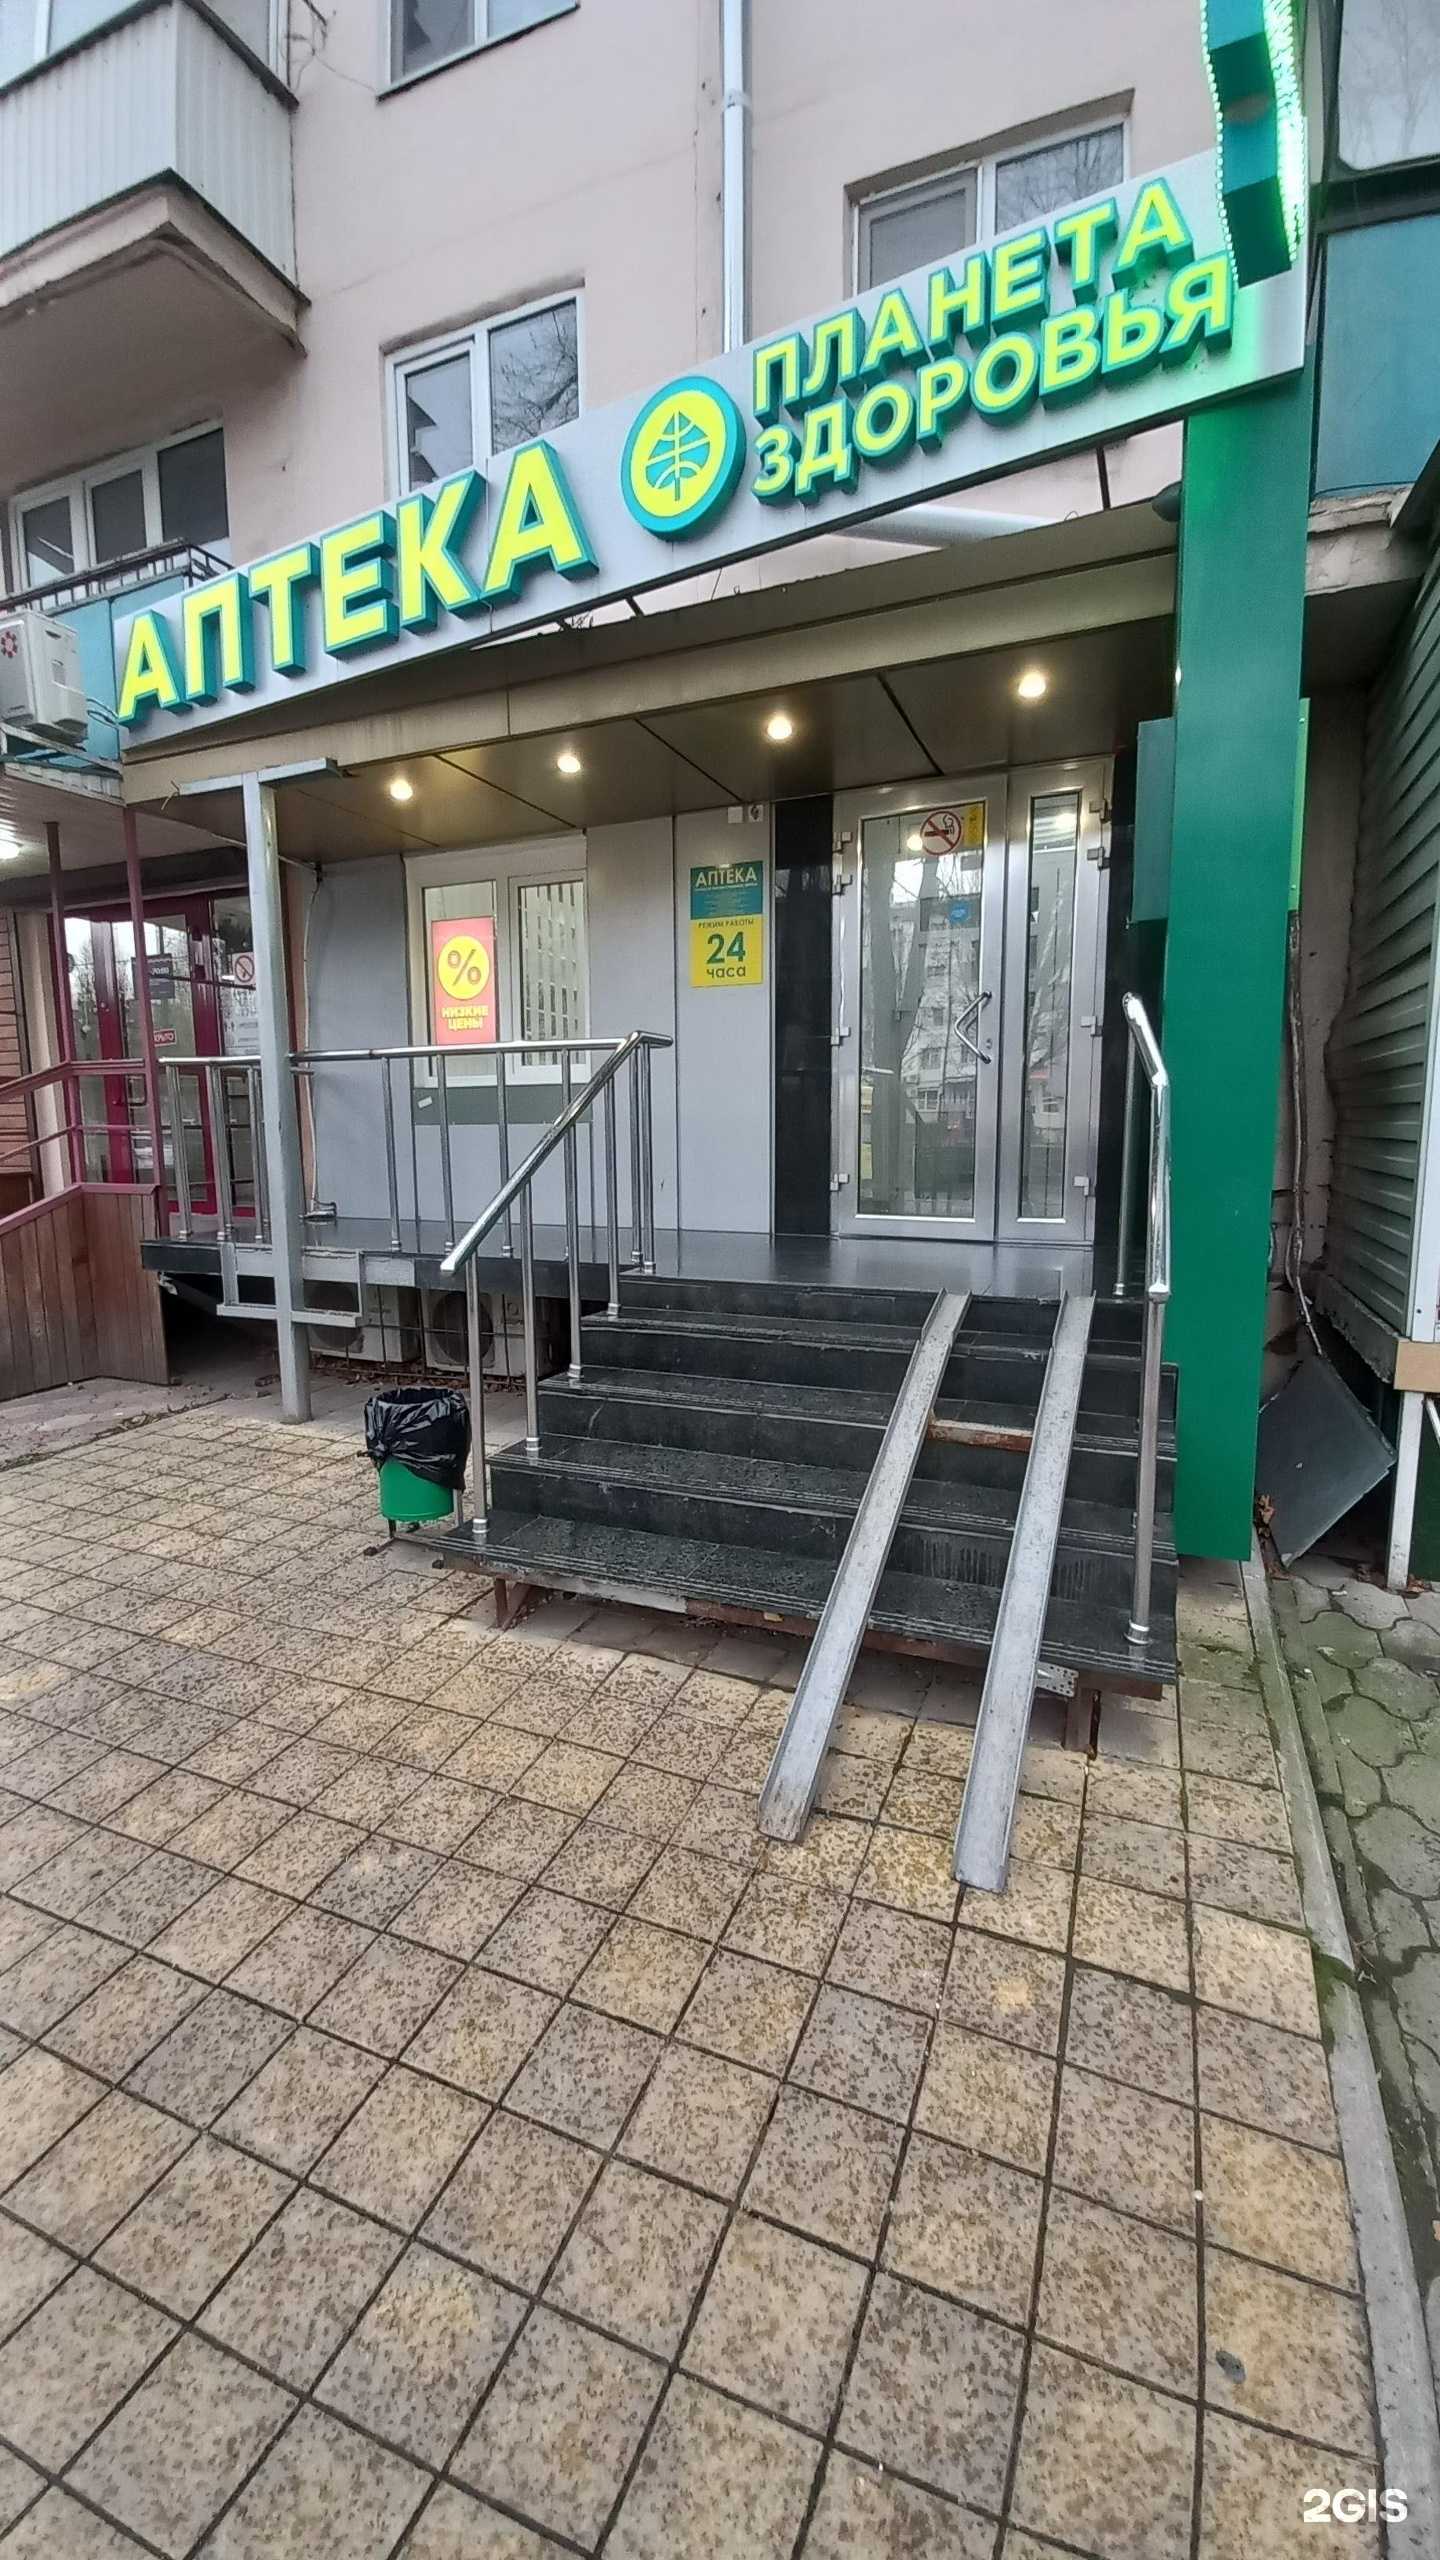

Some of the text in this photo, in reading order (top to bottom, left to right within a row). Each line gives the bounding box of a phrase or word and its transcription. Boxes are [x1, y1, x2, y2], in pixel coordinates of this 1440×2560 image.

[753, 177, 1193, 425] ПЛАНЕТА
[751, 252, 1236, 502] ЗДОРОВЬЯ
[118, 439, 598, 726] АПТЕКА
[695, 866, 758, 888] АПТЕКА
[698, 918, 754, 929] РЕЖИМ РАБОТЫ
[706, 930, 746, 965] 24
[706, 966, 746, 979] часа
[441, 1005, 489, 1018] НИЗКИЕ
[447, 1017, 484, 1032] ЦЕНЫ
